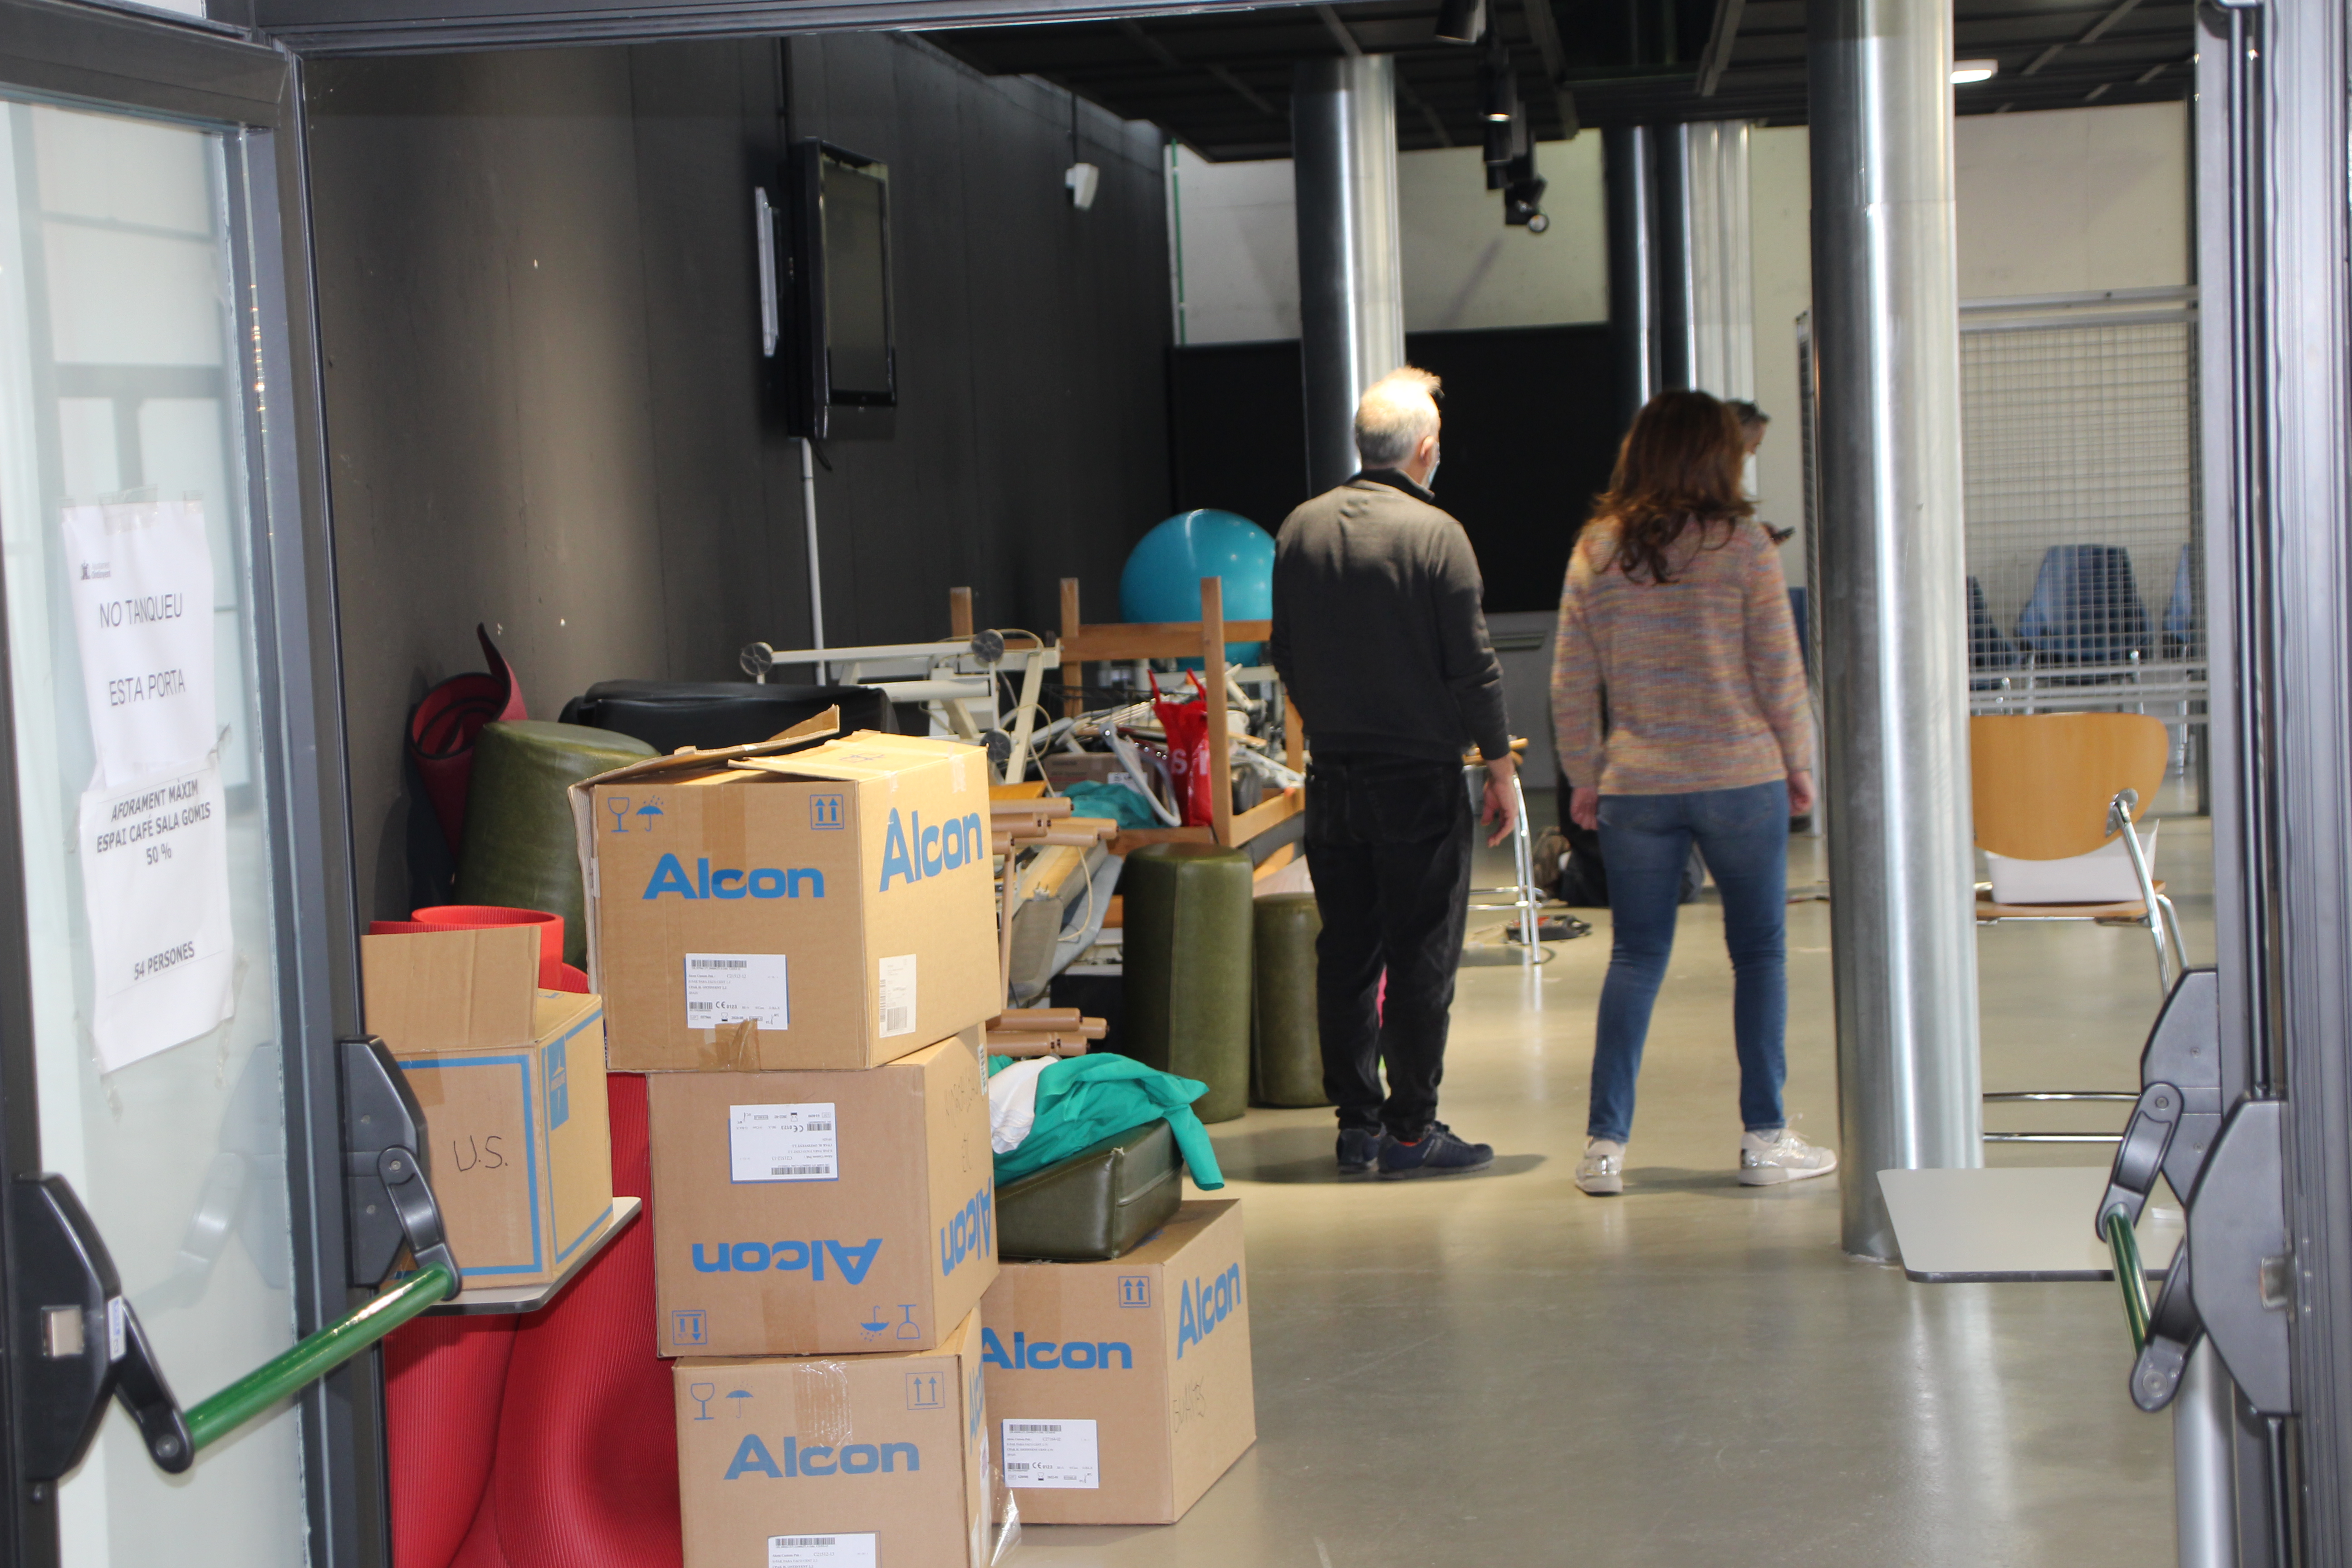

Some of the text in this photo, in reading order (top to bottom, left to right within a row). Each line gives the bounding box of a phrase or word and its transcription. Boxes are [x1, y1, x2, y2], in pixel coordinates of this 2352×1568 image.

[99, 593, 182, 628] NO TANQUEU
[109, 669, 185, 706] ESTA PORTA
[97, 802, 211, 853] ESPAI CAFÉ SALA GOMIS
[111, 789, 166, 822] AFORAMENT
[146, 843, 171, 865] 50 %
[879, 808, 983, 892] Alcon
[642, 853, 824, 899] Alcon
[134, 941, 194, 980] 54 PERSONES
[454, 1135, 508, 1172] U.S.
[941, 1176, 991, 1276] Alcon
[691, 1239, 883, 1285] Alcon
[1177, 1262, 1241, 1360] Alcon
[981, 1327, 1132, 1369] Alcon
[723, 1434, 919, 1480] Alcon
